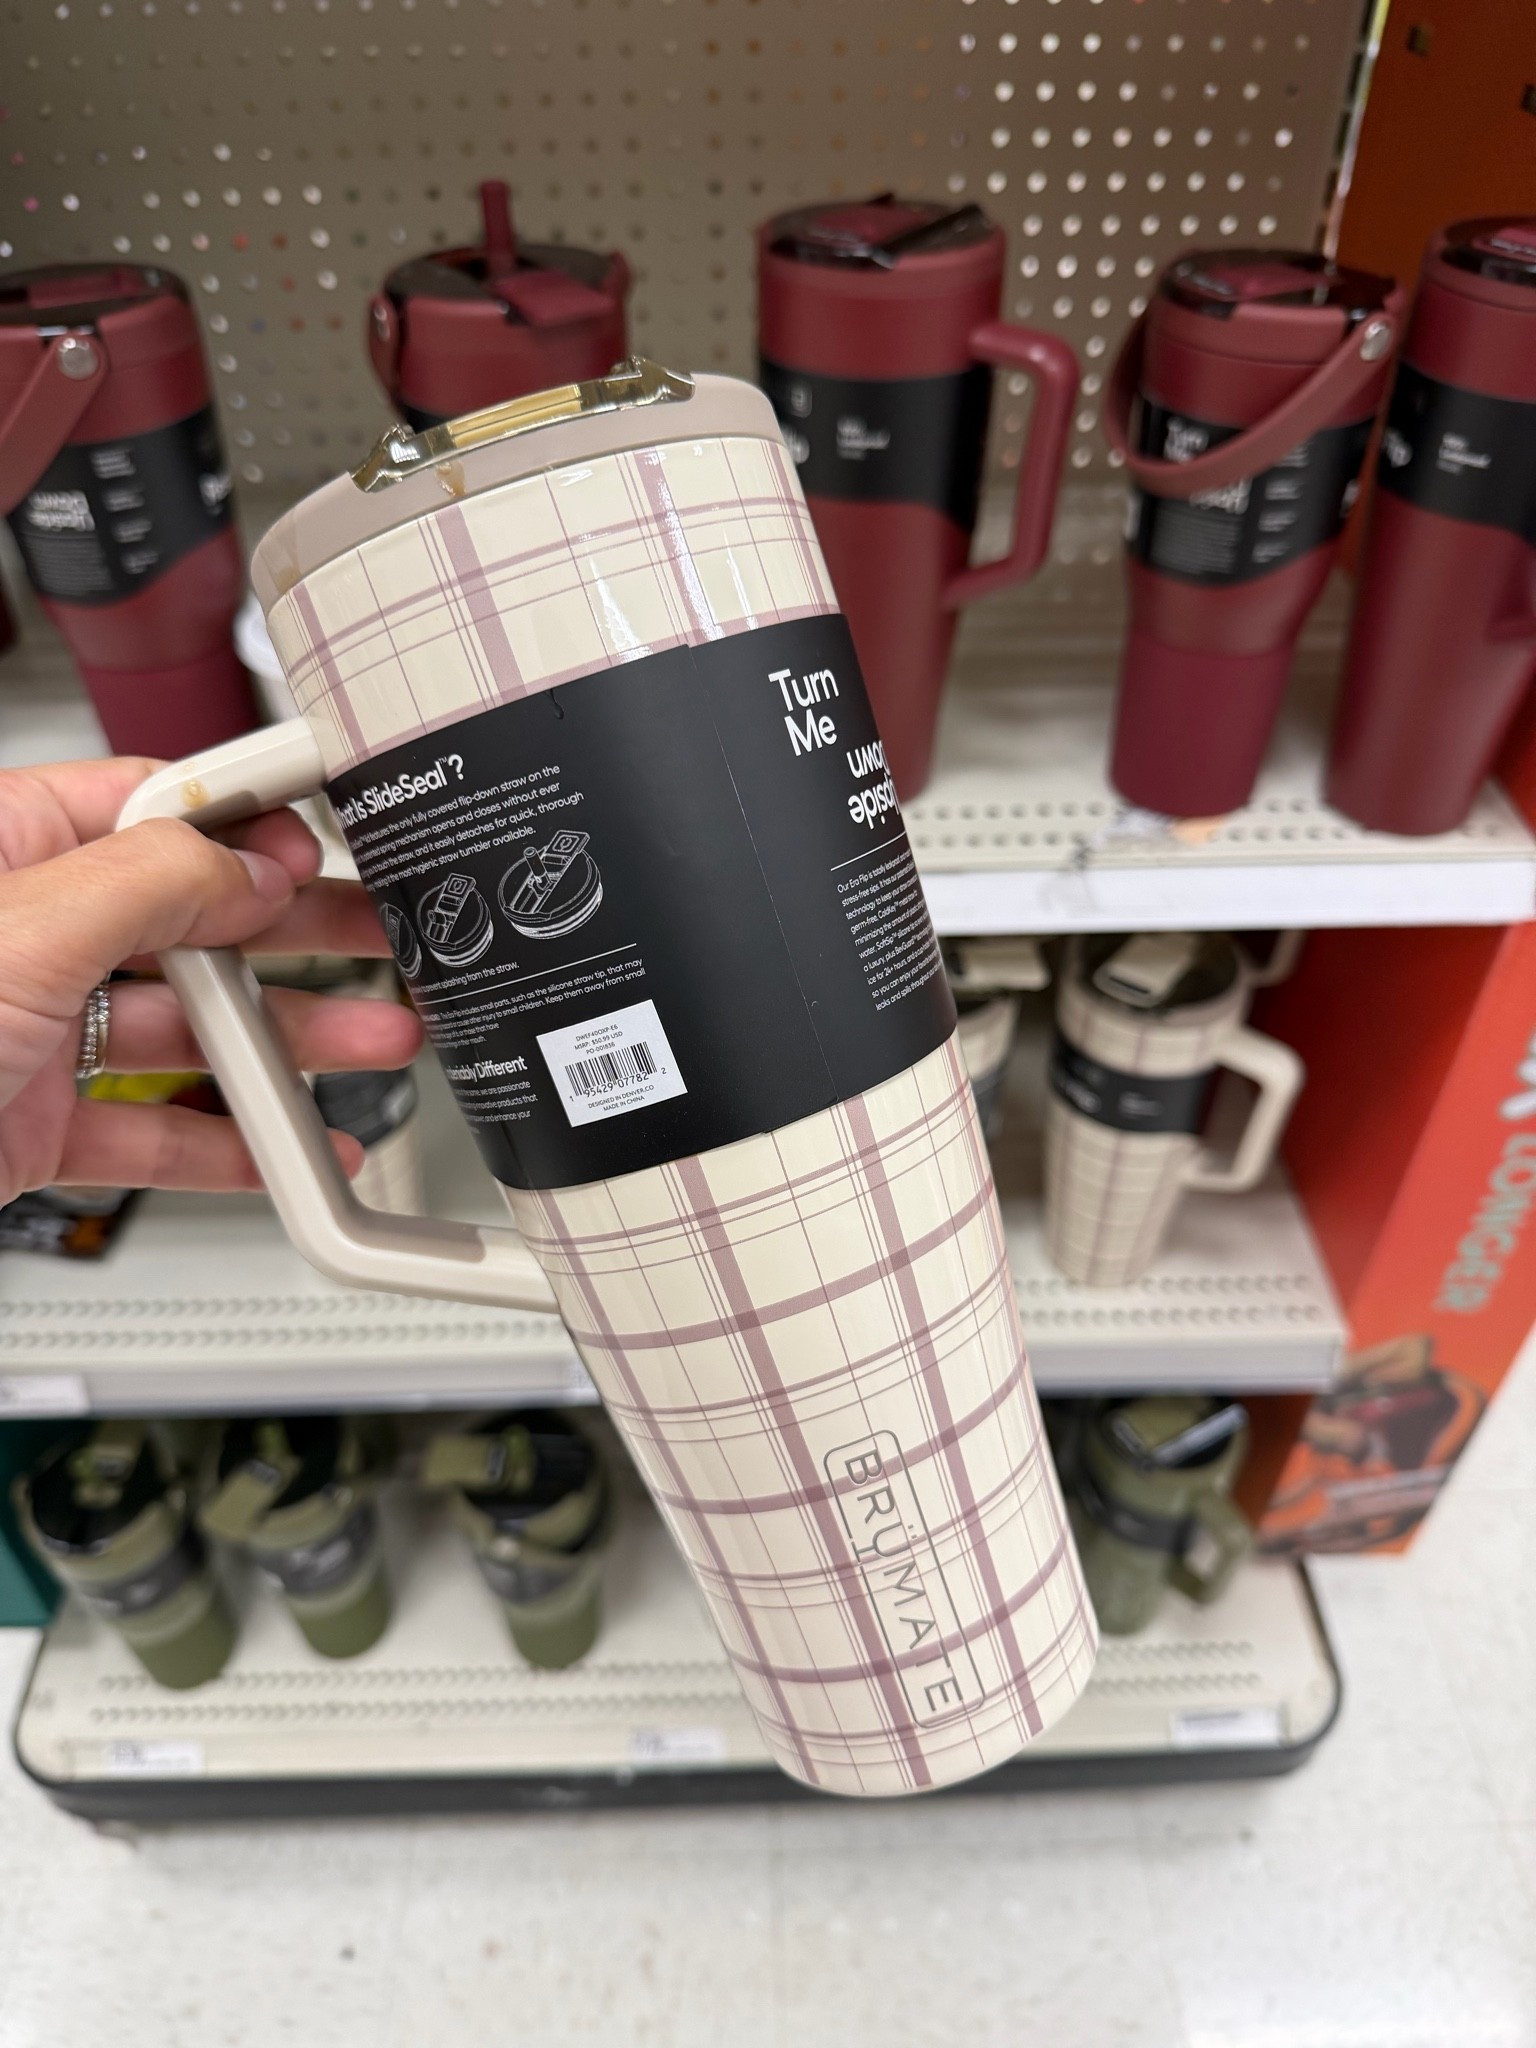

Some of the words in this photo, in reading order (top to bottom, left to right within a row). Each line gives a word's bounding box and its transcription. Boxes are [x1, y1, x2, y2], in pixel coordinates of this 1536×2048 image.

[768, 668, 839, 712] Turn
[784, 708, 838, 756] Me
[351, 796, 368, 820] Is
[389, 823, 400, 834] the
[400, 816, 414, 832] only
[412, 812, 428, 825] fully
[428, 799, 458, 818] covered
[458, 785, 500, 807] flip-down
[500, 776, 527, 792] straw
[528, 772, 542, 783] on
[542, 765, 561, 778] the
[396, 828, 432, 847] mechanism
[432, 819, 456, 836] opens
[456, 810, 474, 825] and
[474, 803, 502, 819] closes
[501, 788, 539, 809] without
[539, 782, 560, 796] ever
[389, 854, 399, 867] the
[415, 844, 430, 857] and
[434, 836, 455, 850] easily
[456, 821, 494, 842] detaches
[494, 817, 508, 829] for
[509, 808, 538, 825] quick,
[537, 791, 584, 815] thorough
[391, 870, 400, 882] the
[399, 868, 414, 880] most
[412, 856, 440, 877] hygienic
[438, 850, 459, 865] straw
[459, 839, 491, 857] tumbler
[492, 825, 537, 847] available.
[838, 883, 850, 893] Our
[849, 878, 860, 888] Era
[858, 874, 868, 884] Flip
[842, 888, 870, 907] stress-free
[846, 901, 876, 920] technology
[880, 892, 892, 902] keep
[854, 926, 884, 947] minimizing
[883, 922, 892, 932] the
[892, 913, 906, 927] amount
[859, 946, 878, 959] water,
[885, 950, 896, 962] plus
[440, 975, 468, 990] splashing
[466, 971, 484, 984] from
[483, 967, 496, 978] the
[496, 961, 520, 974] straw.
[461, 1006, 481, 1017] includes
[480, 1002, 494, 1012] small
[511, 994, 526, 1004] such
[534, 987, 548, 997] the
[548, 980, 574, 993] silicone
[574, 974, 594, 986] straw
[594, 970, 608, 980] tip,
[607, 964, 624, 976] that
[624, 958, 644, 970] may
[867, 977, 876, 986] ice
[876, 972, 884, 980] for
[884, 966, 893, 976] 24+
[872, 990, 880, 998] so
[879, 984, 890, 996] you
[890, 978, 900, 988] can
[900, 972, 911, 983] enjoy
[470, 1016, 482, 1025] other
[482, 1012, 496, 1023] injury
[496, 1010, 503, 1018] to
[502, 1006, 519, 1017] small
[519, 1000, 546, 1012] children.
[545, 993, 564, 1005] Keep
[564, 987, 584, 999] them
[584, 981, 606, 993] away
[605, 975, 625, 987] from
[624, 967, 647, 981] small
[876, 998, 890, 1011] leaks
[890, 990, 902, 1003] and
[475, 1024, 486, 1033] that
[486, 1022, 500, 1032] have
[574, 1040, 590, 1050] MSRP:
[592, 1034, 610, 1046] $50.99
[610, 1030, 623, 1040] USD
[474, 1056, 528, 1079] Different
[480, 1088, 488, 1096] we
[498, 1080, 531, 1095] passionate
[584, 1082, 614, 1098] 95429
[617, 1072, 650, 1088] 07782
[497, 1096, 522, 1108] products
[522, 1093, 538, 1103] that
[588, 1096, 615, 1110] DESIGNED
[604, 1102, 620, 1112] MADE
[626, 1096, 645, 1106] CHINA
[516, 1110, 531, 1120] your
[844, 1448, 964, 1712] BRÜMATE
